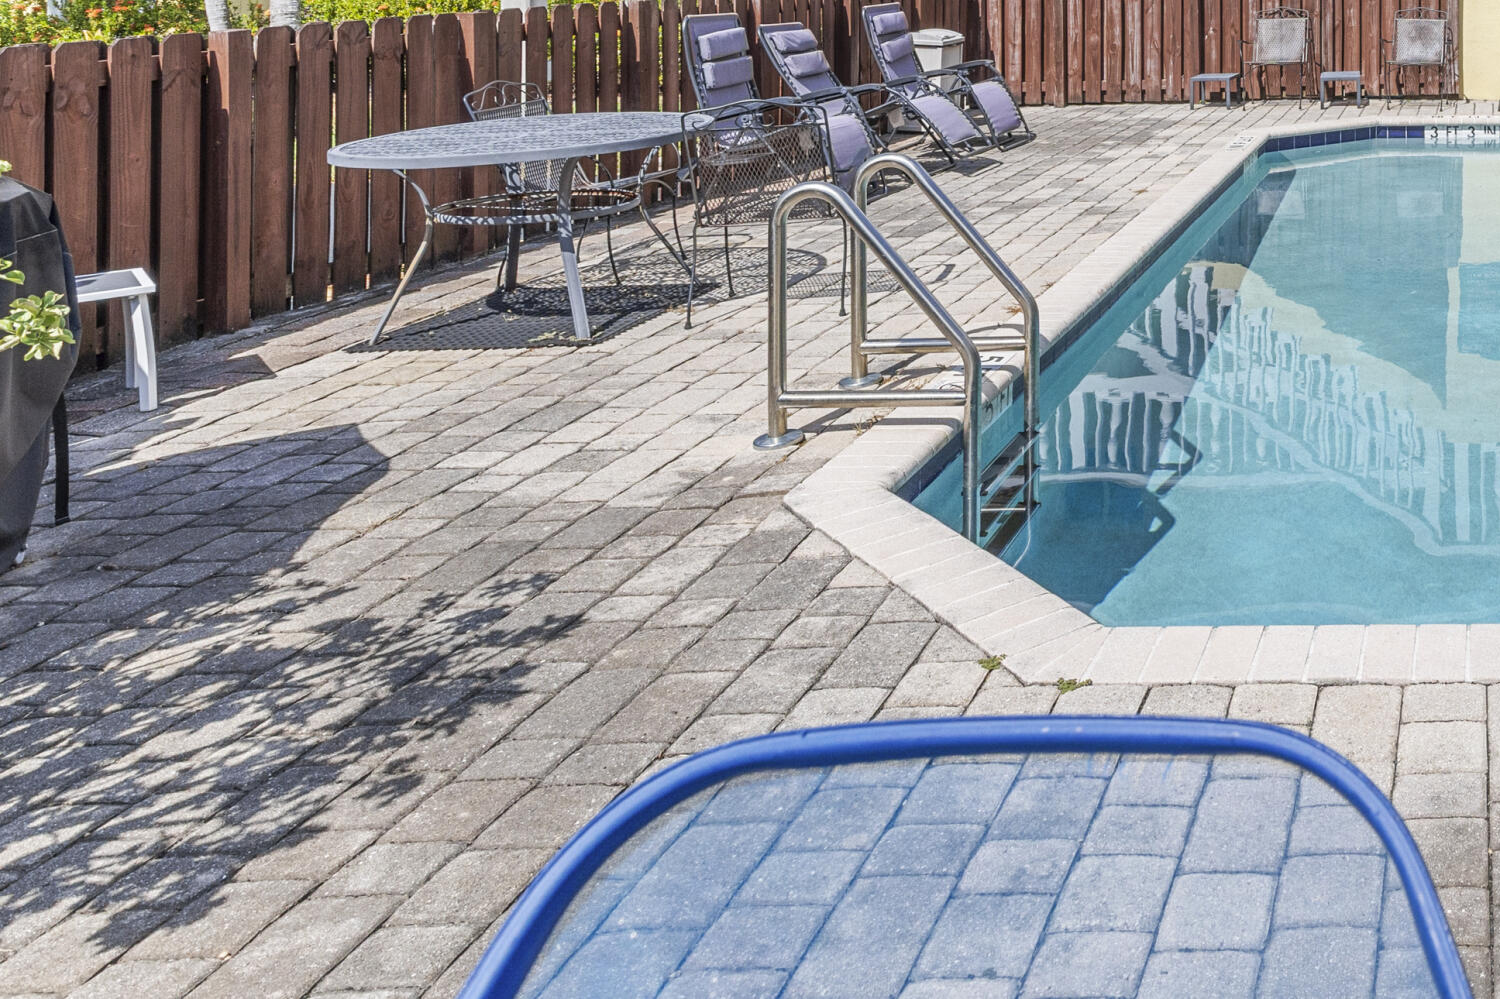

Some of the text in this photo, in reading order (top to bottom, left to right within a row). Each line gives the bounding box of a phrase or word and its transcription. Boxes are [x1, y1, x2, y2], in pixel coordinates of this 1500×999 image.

[1430, 125, 1496, 138] 3 FT 3 IN
